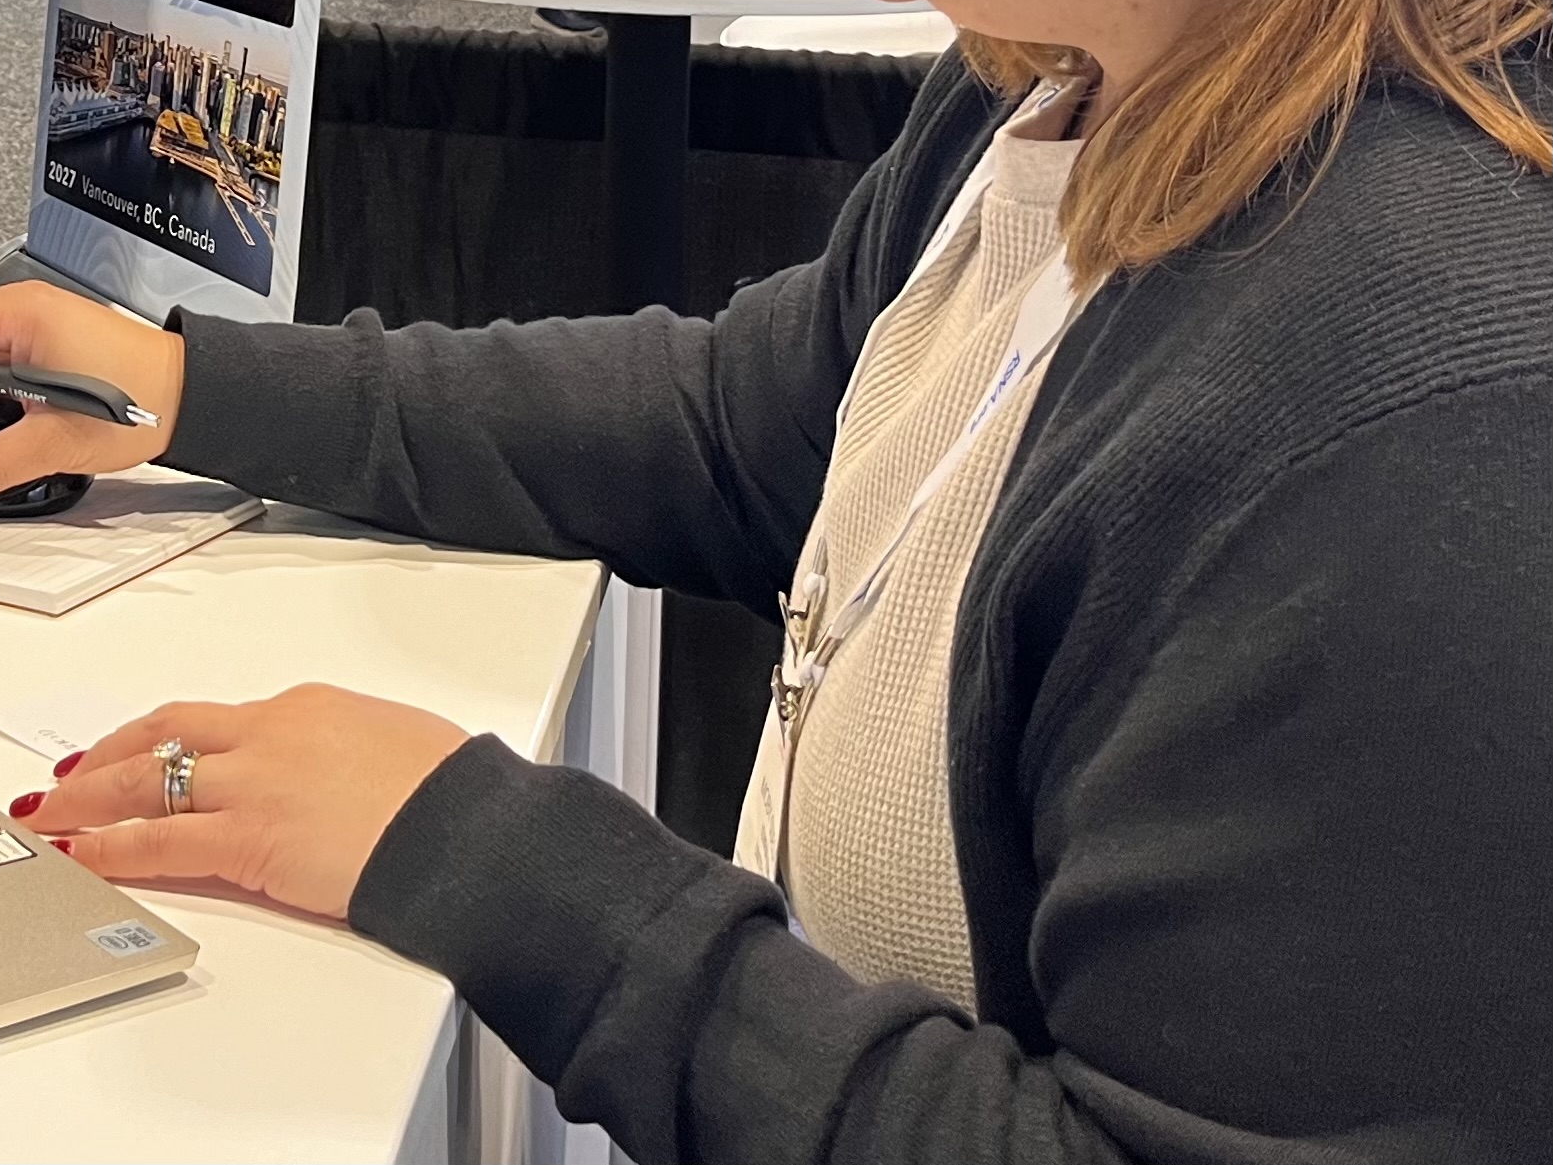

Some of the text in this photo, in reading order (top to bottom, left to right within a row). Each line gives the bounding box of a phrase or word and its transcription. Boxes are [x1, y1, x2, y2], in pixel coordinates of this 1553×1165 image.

[48, 160, 216, 255] 2027 Vancouver, BC, Canada
